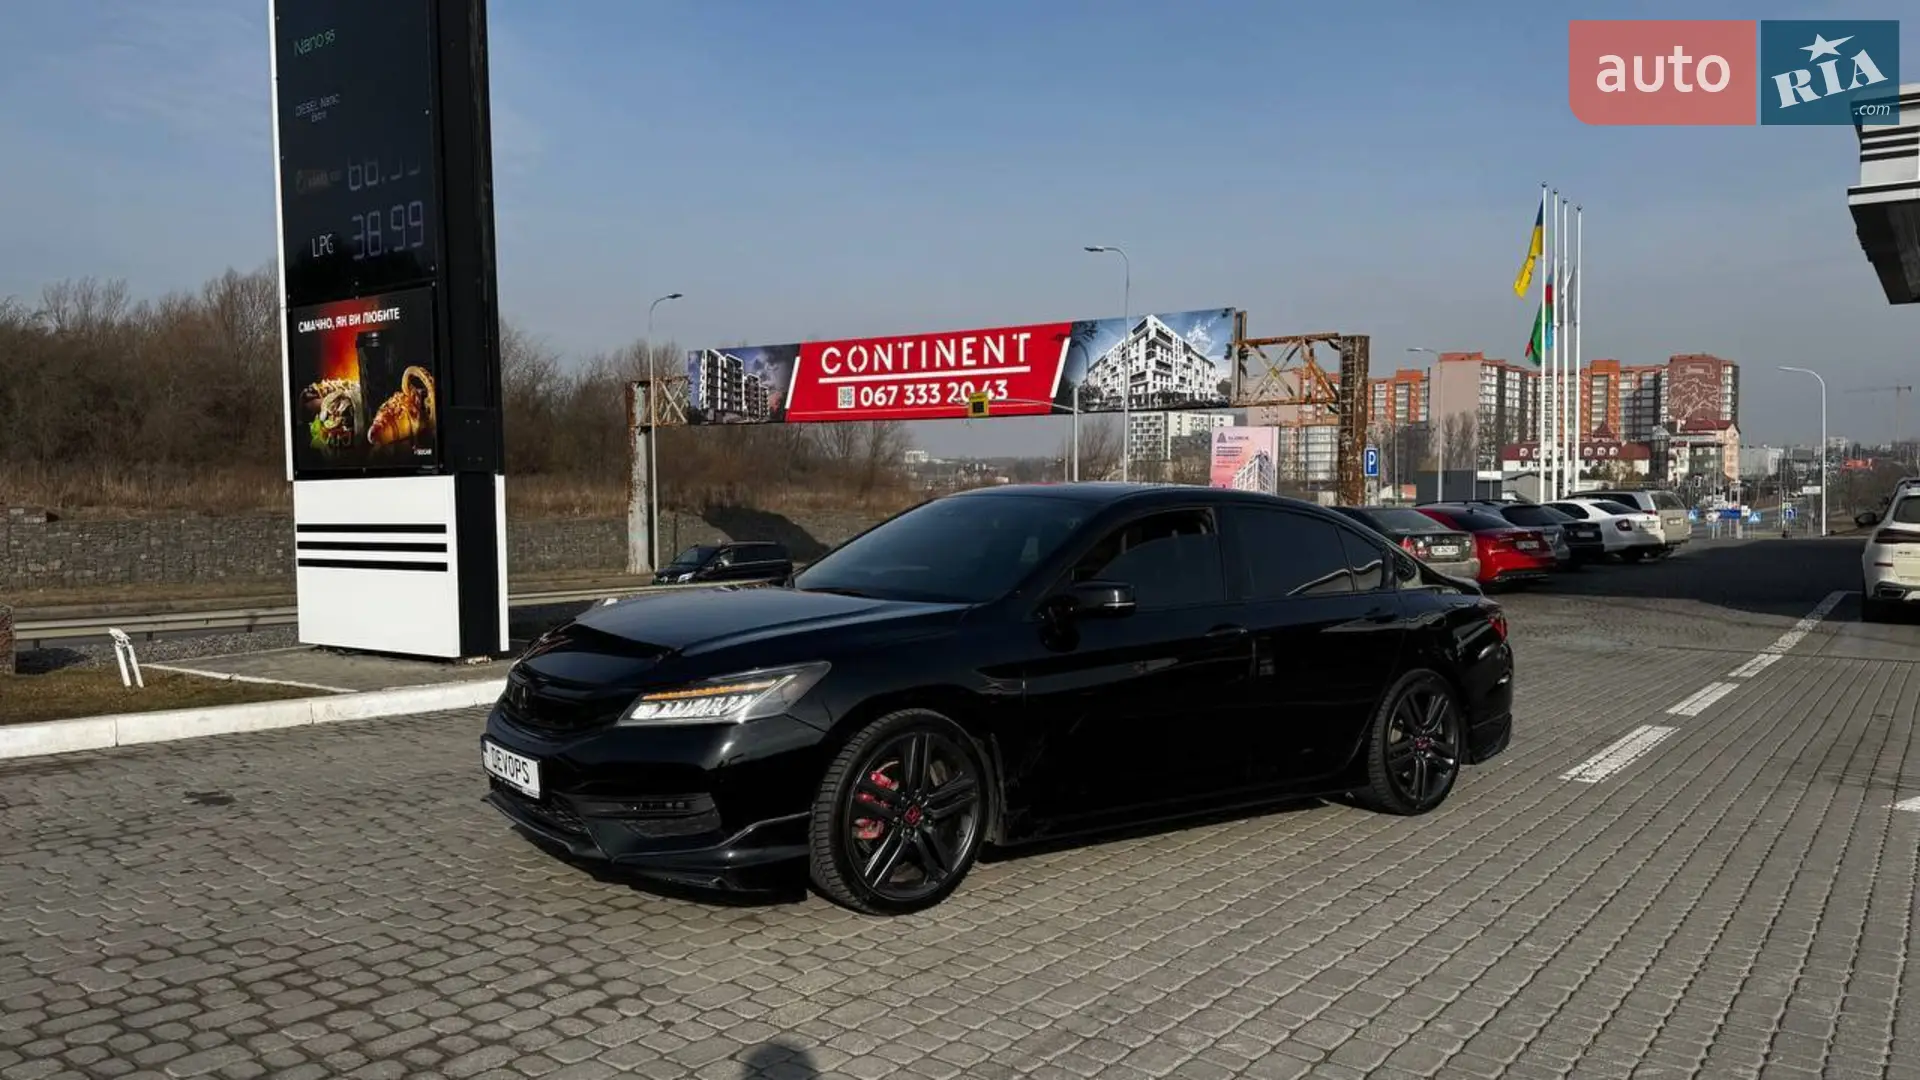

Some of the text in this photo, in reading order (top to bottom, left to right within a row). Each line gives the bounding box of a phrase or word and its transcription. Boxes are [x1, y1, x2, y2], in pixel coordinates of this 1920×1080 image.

[311, 233, 334, 258] LPG
[351, 200, 424, 261] 38.99
[298, 306, 400, 333] СМАЧНО, ЯК ВИ ЛЮБИТЕ
[820, 332, 1031, 375] CONTINENT
[860, 385, 898, 407] 067
[904, 383, 941, 405] 333
[491, 746, 530, 785] DEVOPS
